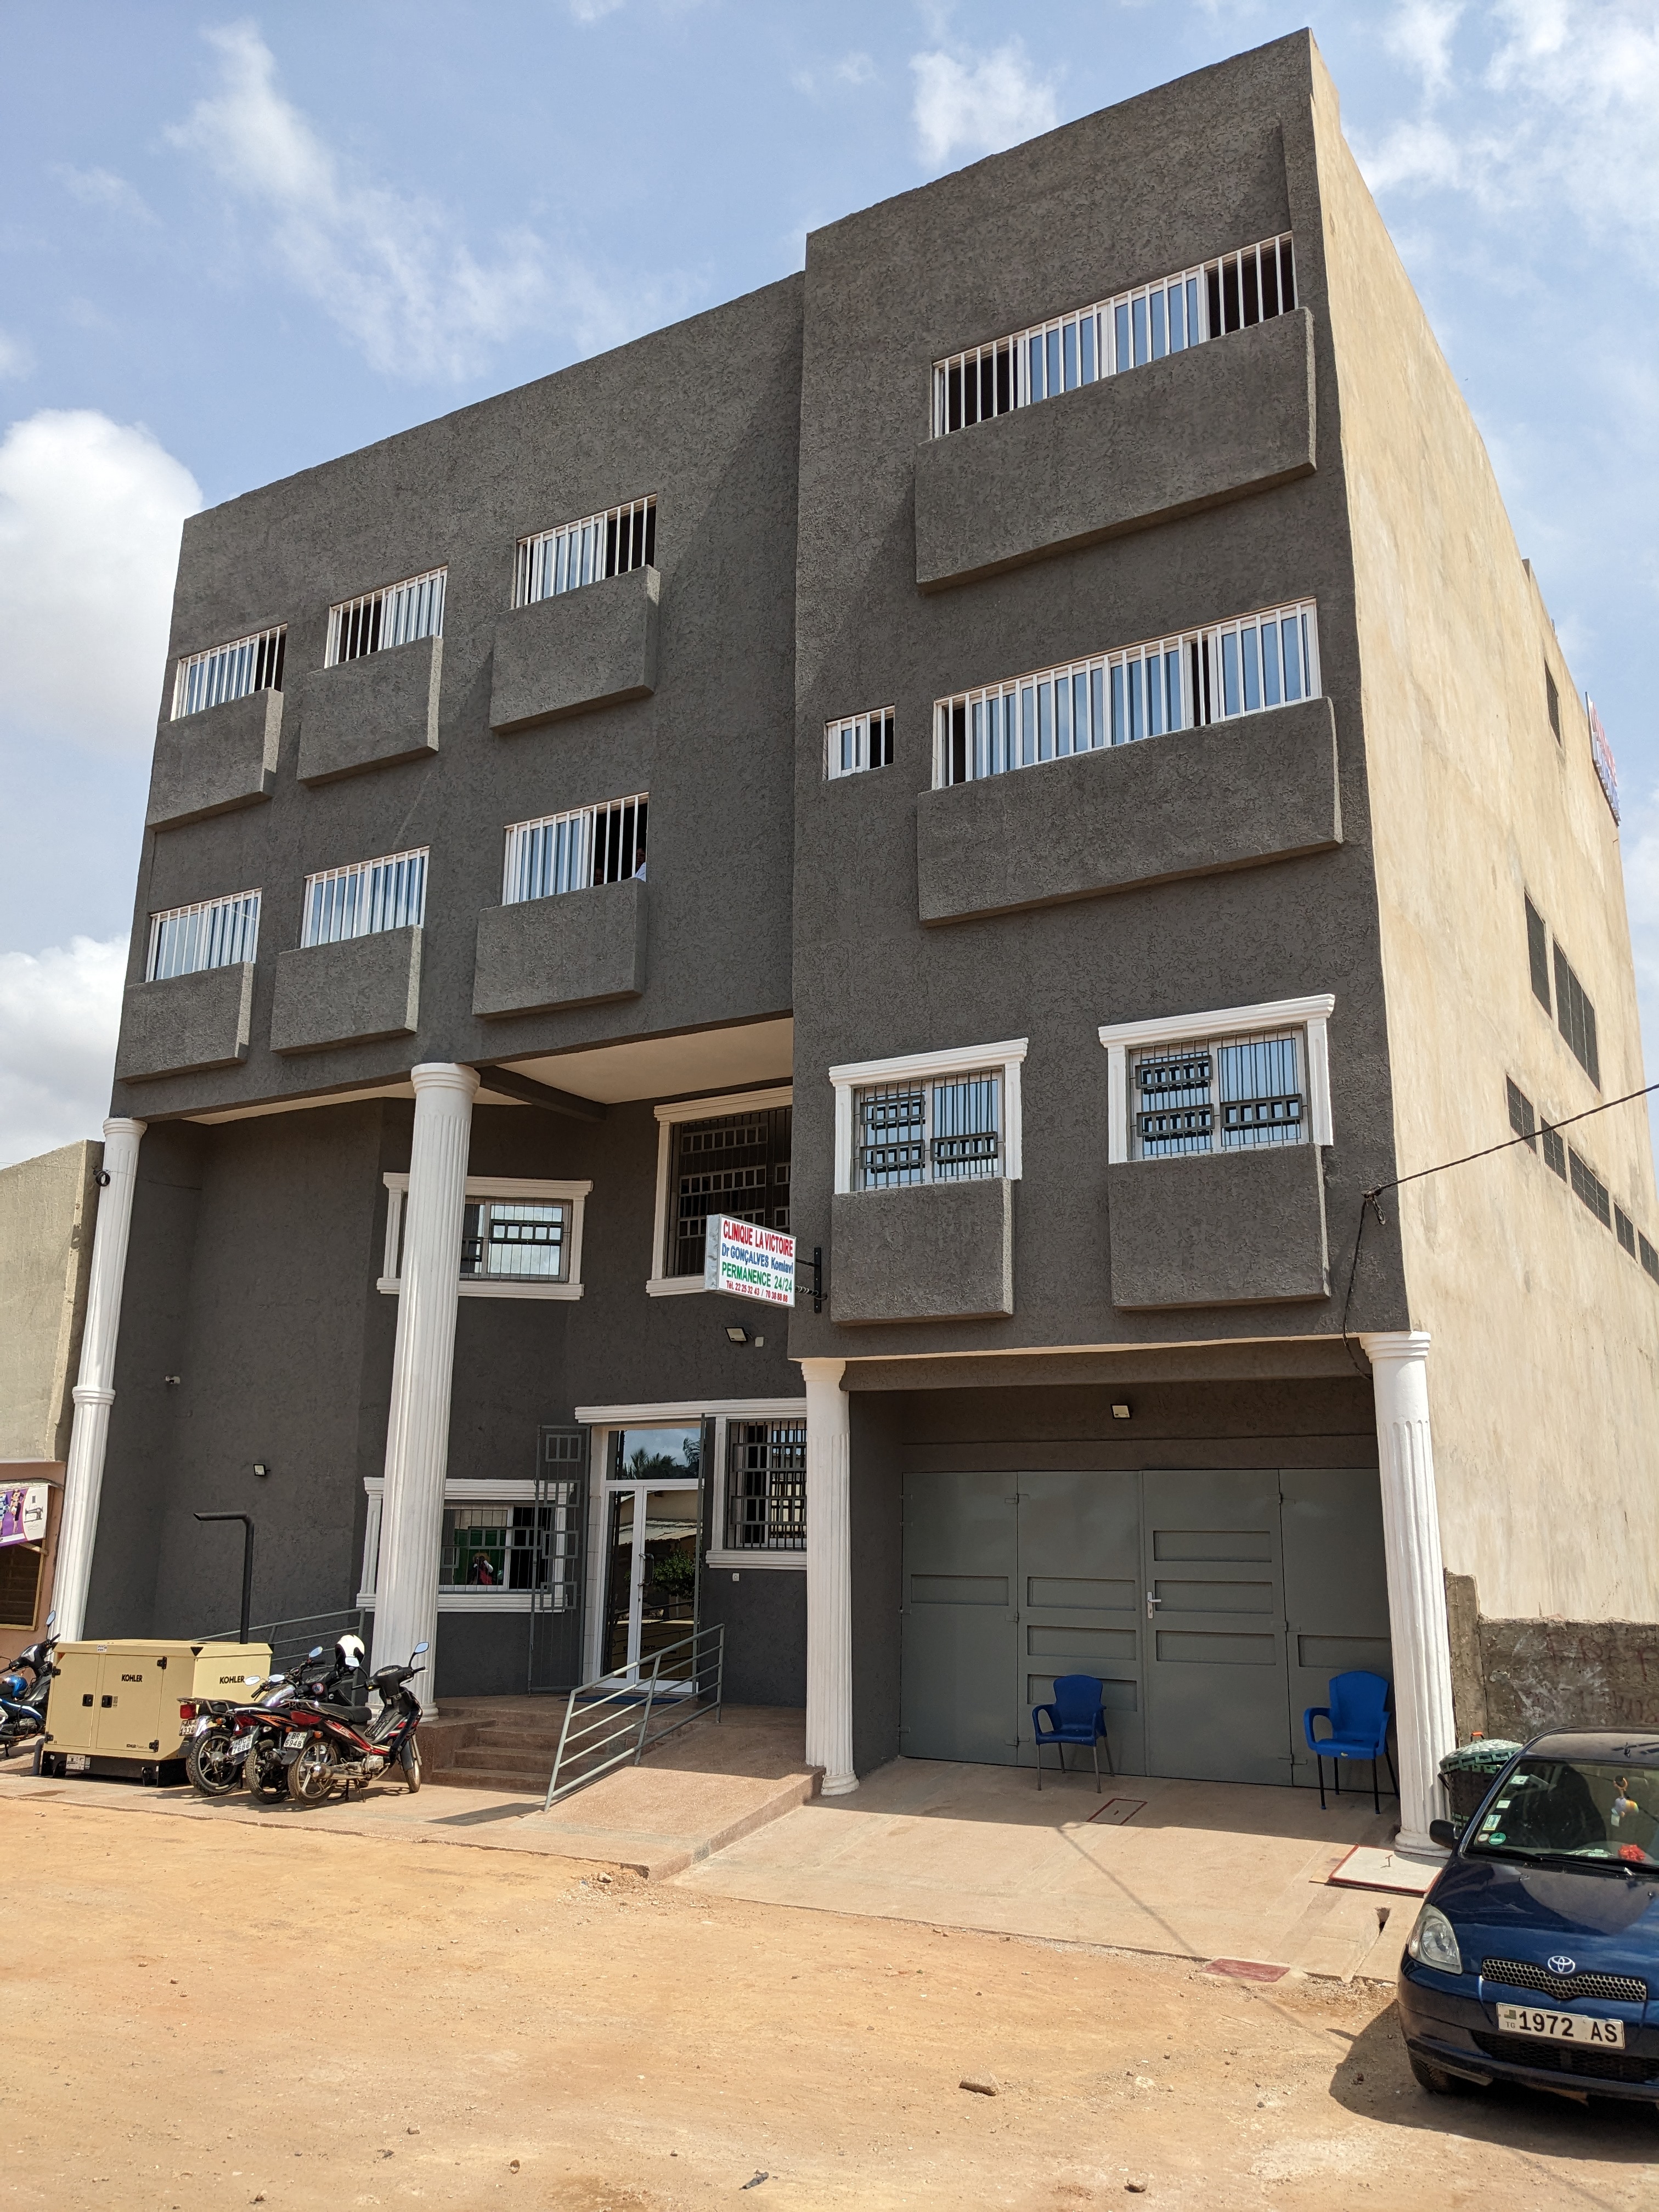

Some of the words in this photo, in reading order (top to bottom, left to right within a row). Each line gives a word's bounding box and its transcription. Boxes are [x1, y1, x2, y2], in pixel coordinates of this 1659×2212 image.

[723, 1220, 753, 1246] CLINIQUE
[755, 1229, 764, 1249] LA
[765, 1232, 793, 1257] VICTOIRE
[721, 1243, 730, 1257] Dr
[730, 1245, 769, 1268] GONÇALVES
[771, 1256, 793, 1274] Komlavi
[721, 1261, 771, 1288] PERMANENCE
[774, 1275, 792, 1293] 24/24
[735, 1282, 741, 1291] 22
[741, 1284, 747, 1293] 25
[747, 1285, 753, 1294] 32
[754, 1287, 760, 1296] 43
[766, 1289, 771, 1299] 70
[121, 1674, 143, 1683] KOHLER
[219, 1675, 245, 1684] KOHLER
[233, 1742, 250, 1753] 7686
[1519, 2011, 1574, 2038] 1972
[1590, 2021, 1617, 2043] AS
